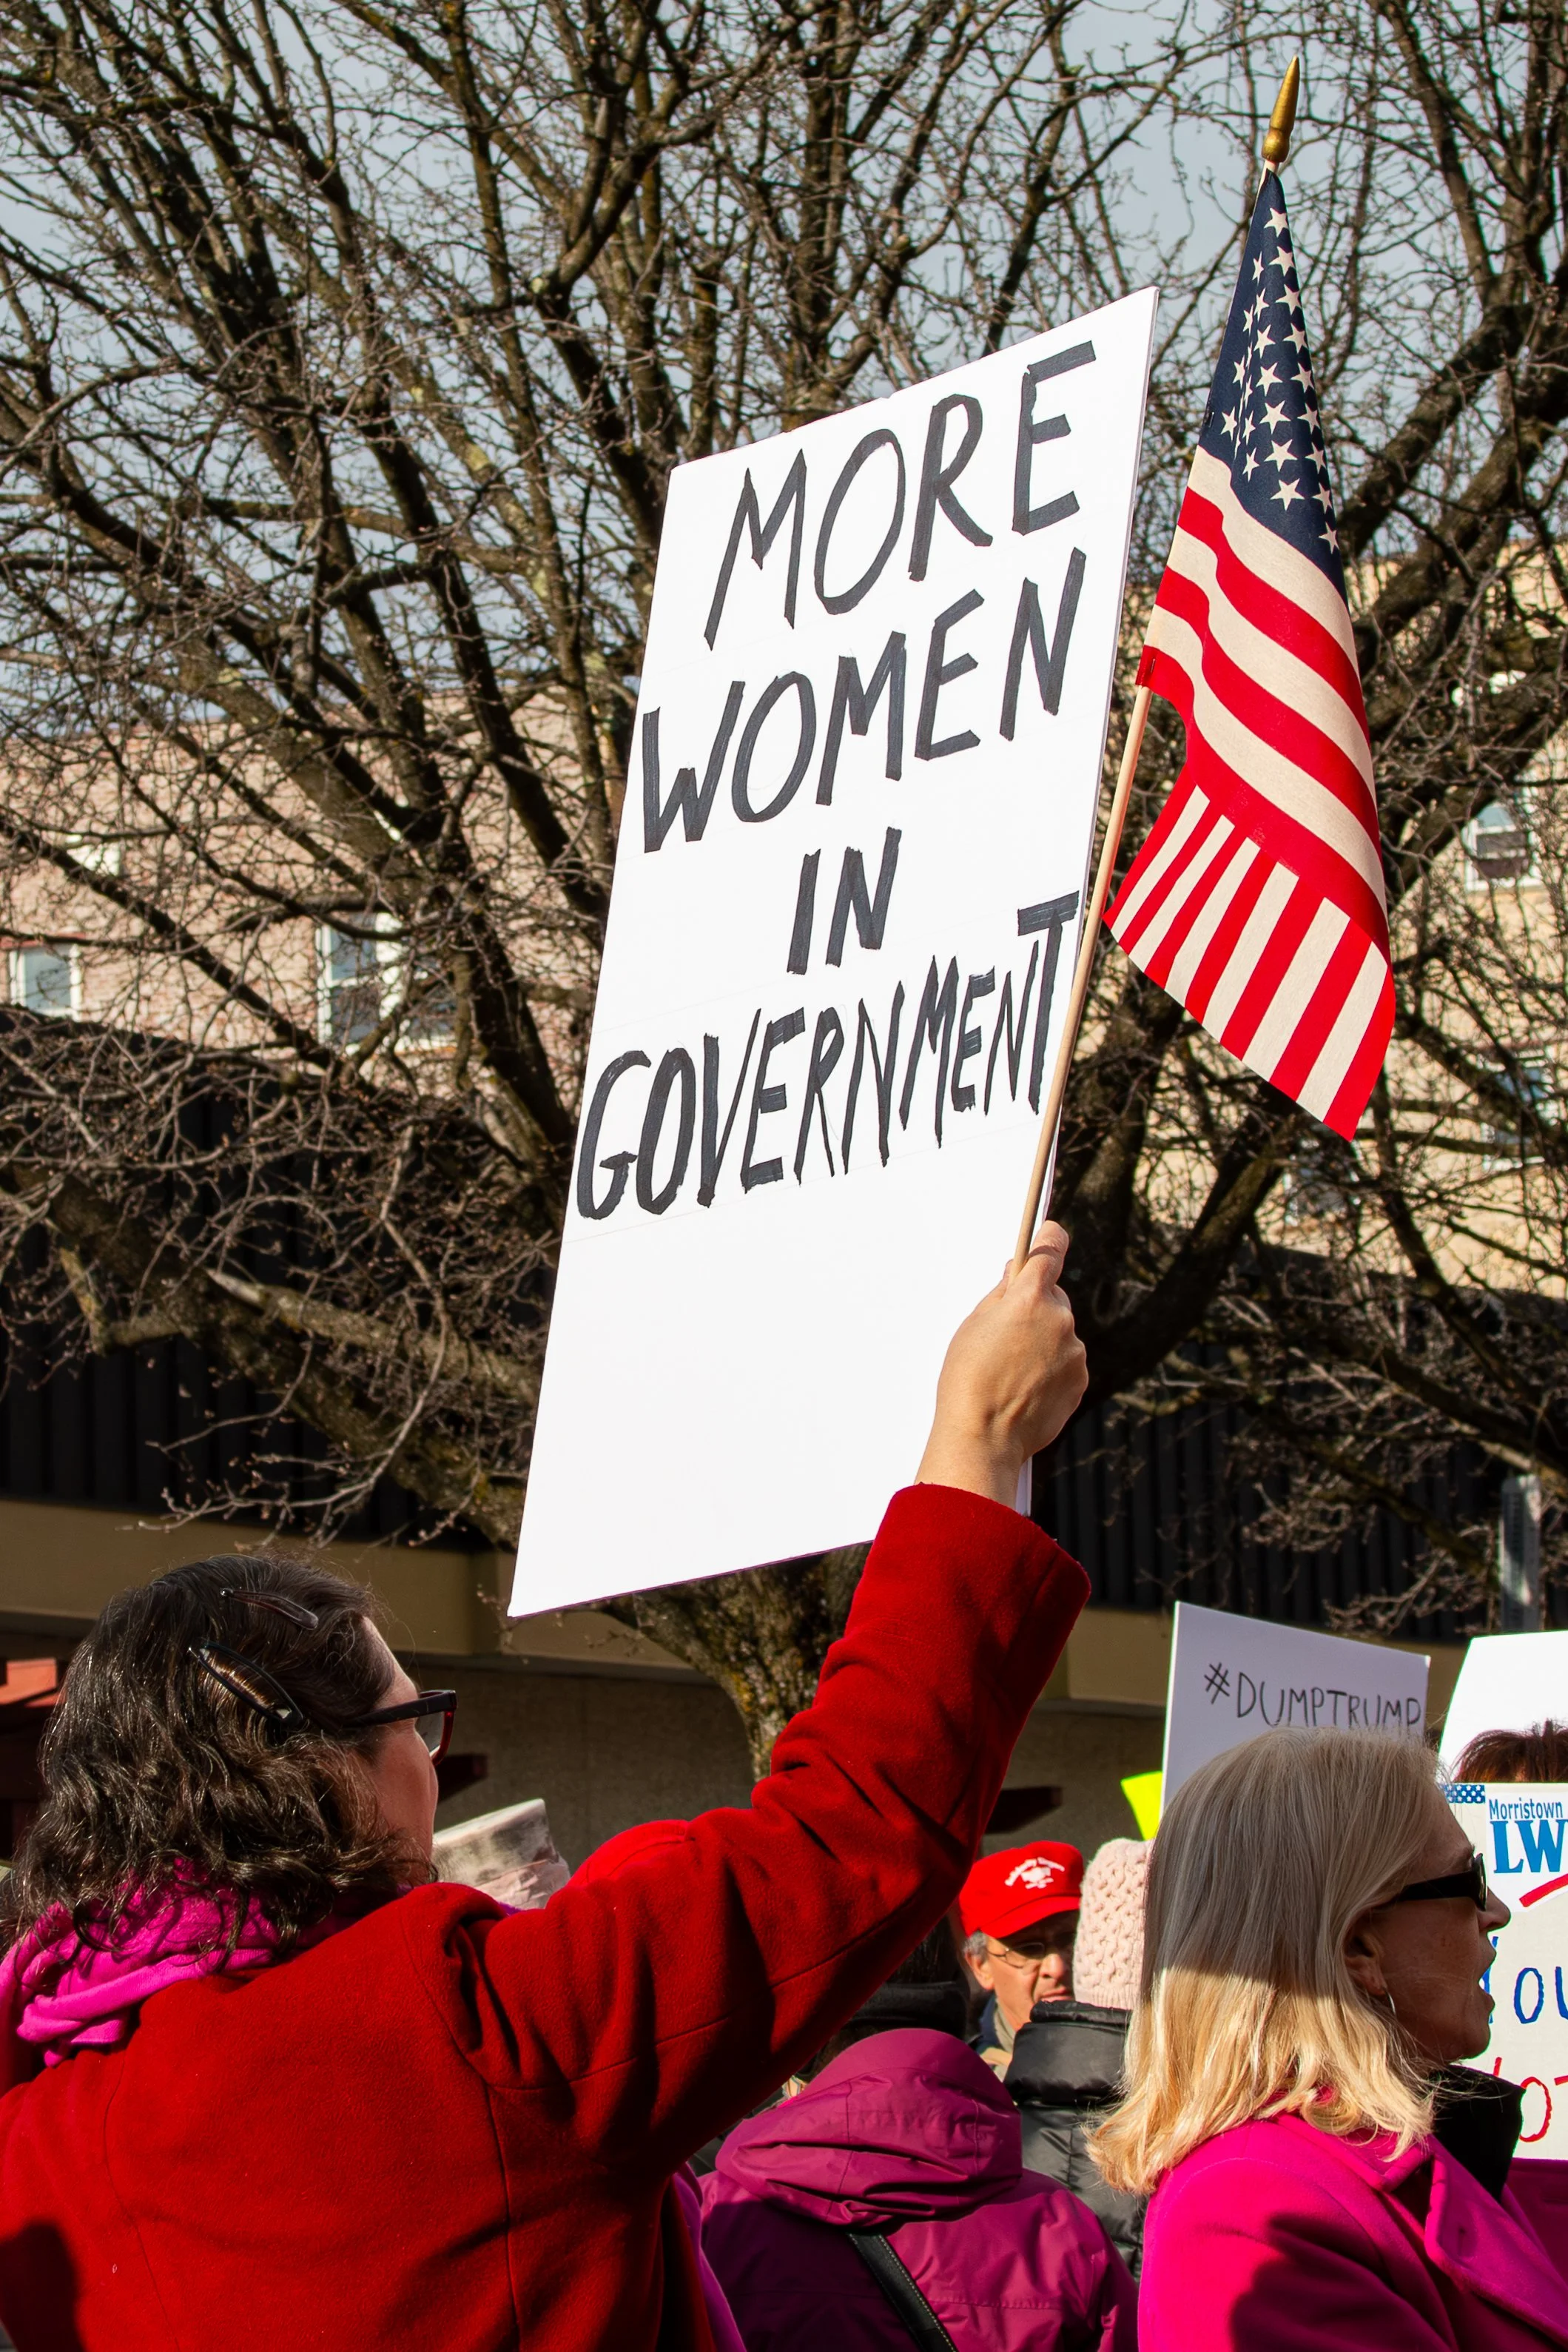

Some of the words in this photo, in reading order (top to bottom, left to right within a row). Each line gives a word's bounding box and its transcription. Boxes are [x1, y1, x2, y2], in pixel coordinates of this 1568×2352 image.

[704, 340, 1097, 651] MORE
[642, 547, 1086, 854] WOMEN
[787, 827, 901, 975] IN
[577, 890, 1080, 1220] GOVERNMENT
[1489, 1798, 1563, 1820] Morristown
